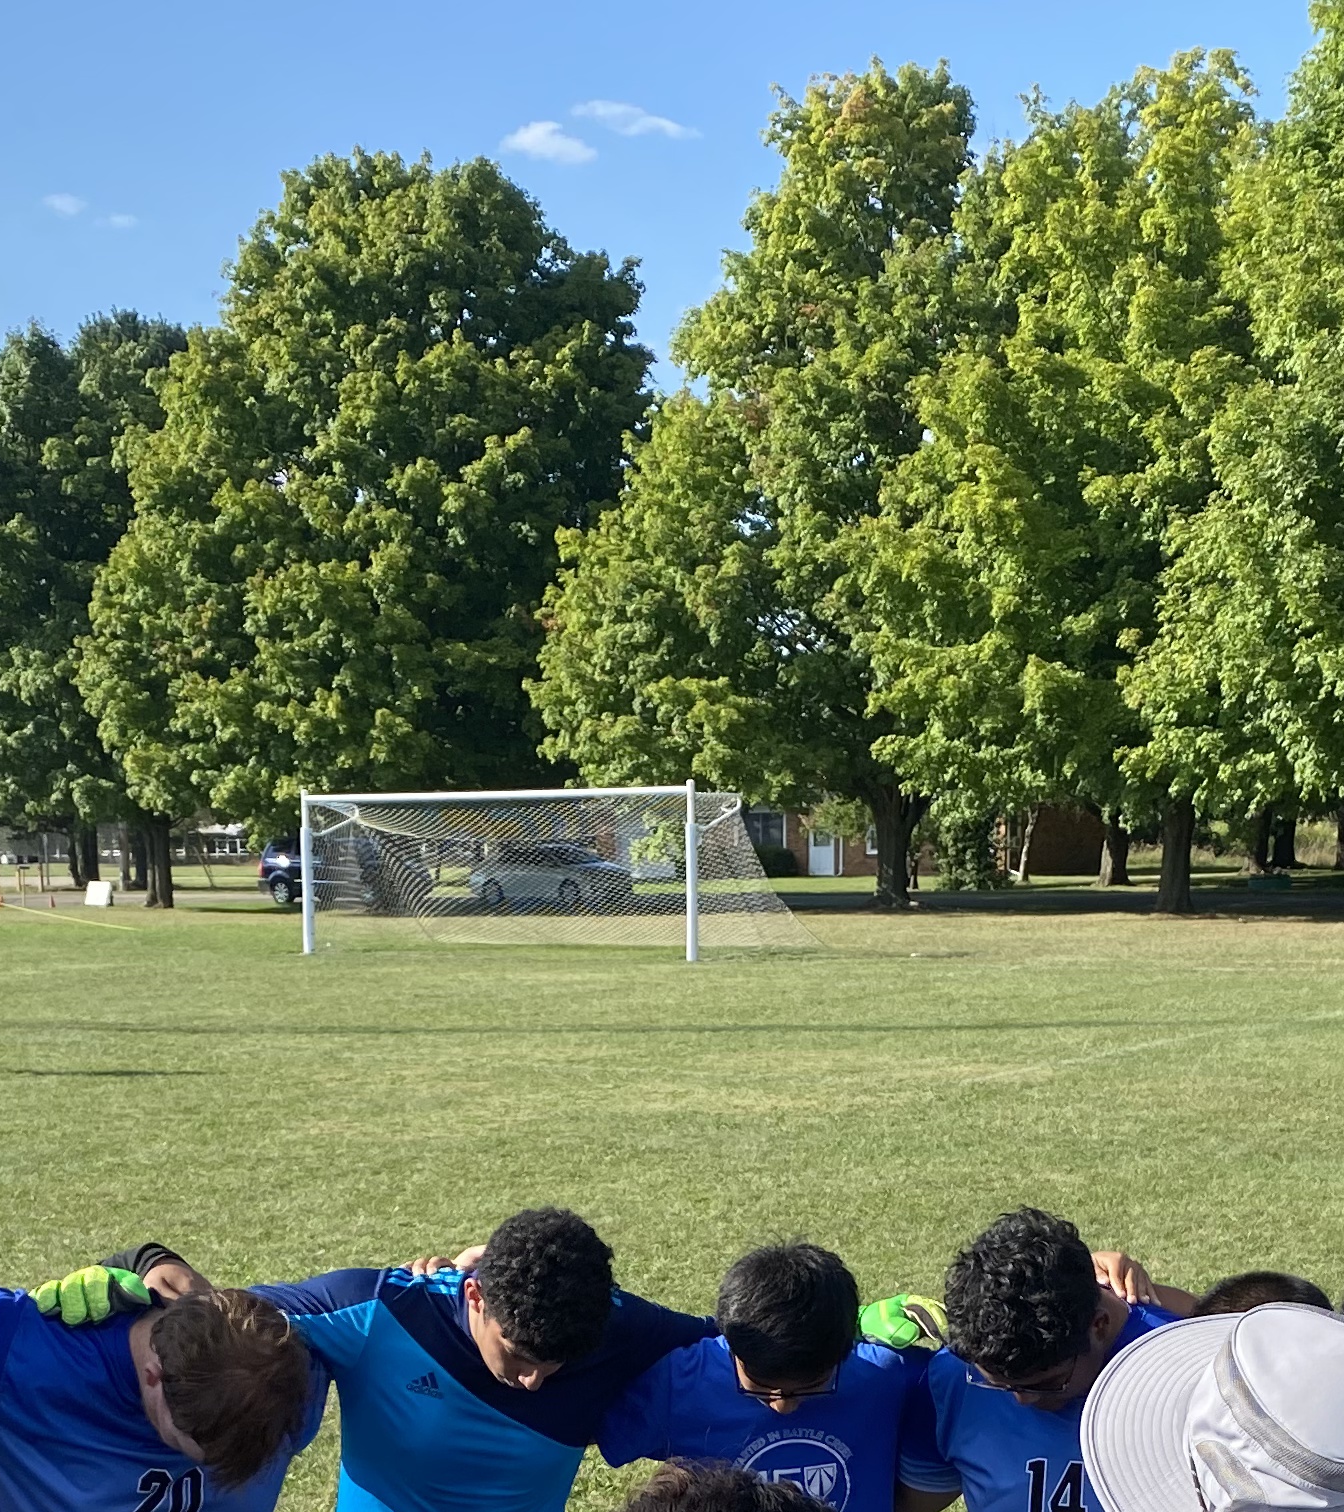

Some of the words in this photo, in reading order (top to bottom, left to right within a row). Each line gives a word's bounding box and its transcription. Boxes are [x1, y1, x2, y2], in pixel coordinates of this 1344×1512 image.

[767, 1430, 781, 1442] IN
[782, 1427, 825, 1441] BATTLE
[824, 1434, 854, 1461] CREEK
